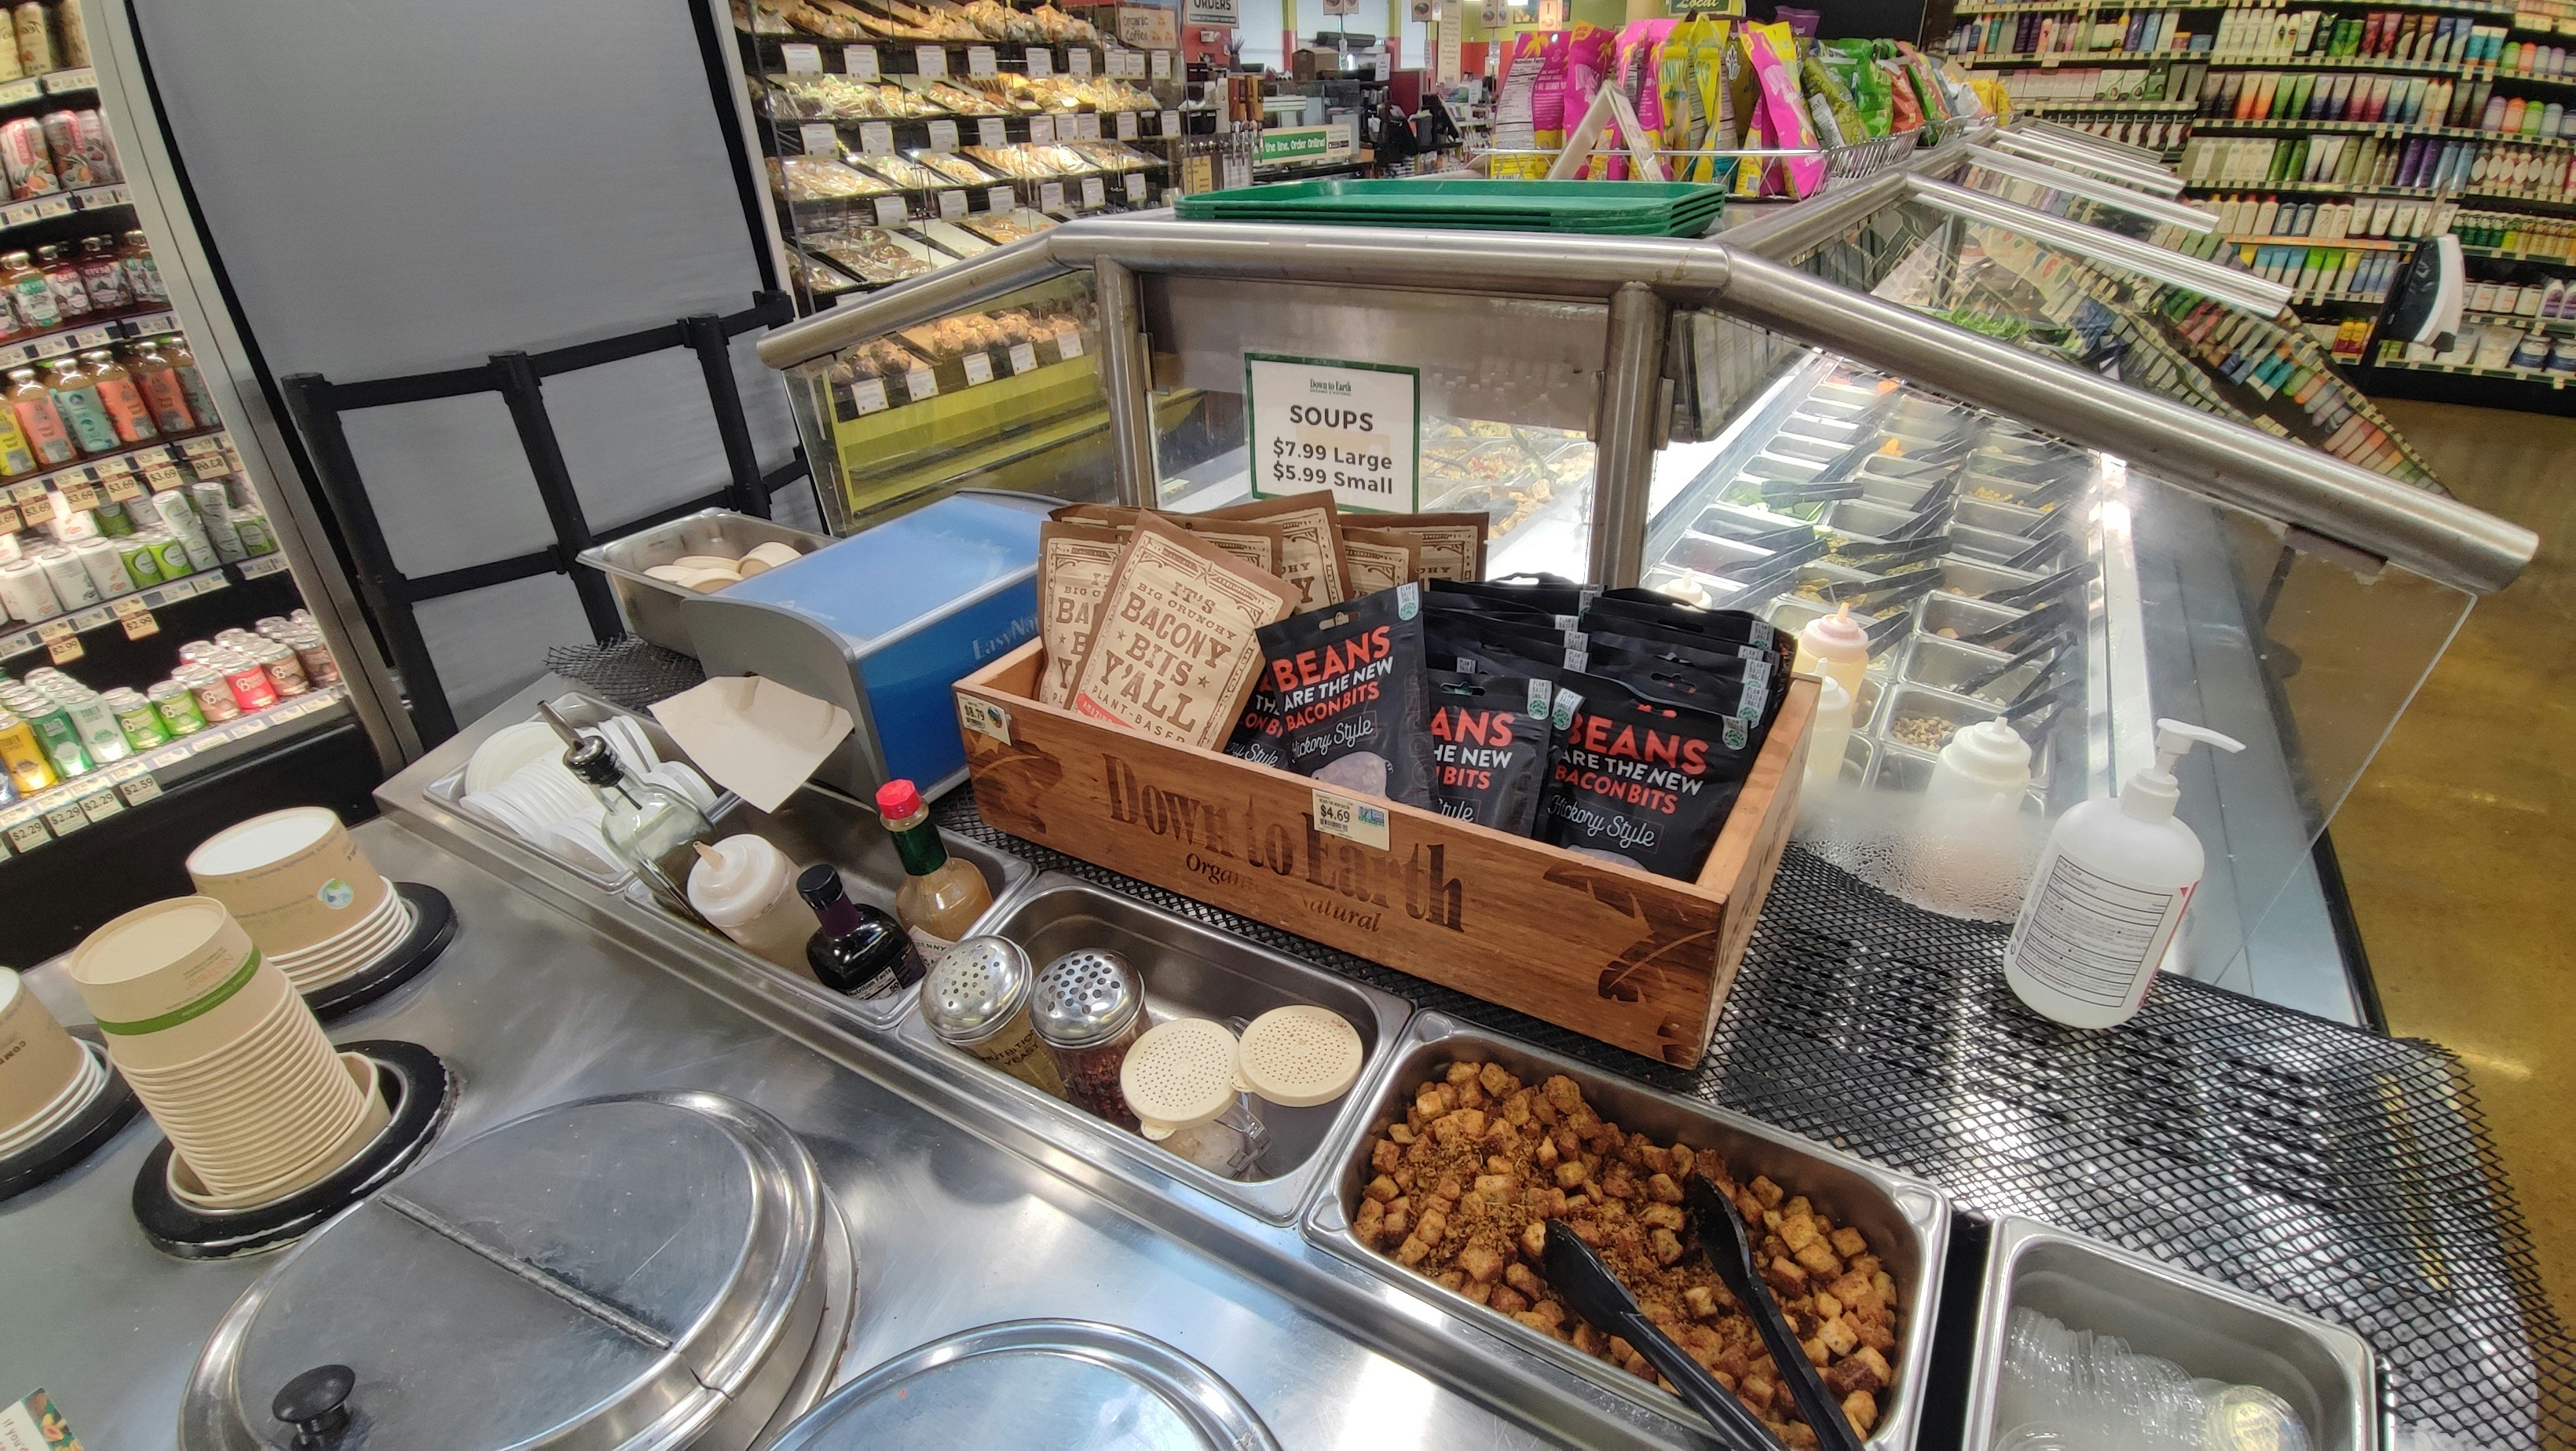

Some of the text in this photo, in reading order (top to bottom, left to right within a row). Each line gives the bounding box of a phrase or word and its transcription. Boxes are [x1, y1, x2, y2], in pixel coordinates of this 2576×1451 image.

[1123, 16, 1150, 30] Organic
[1125, 30, 1148, 42] Coffee
[1265, 142, 1276, 152] the
[1290, 139, 1307, 150] Order
[1310, 378, 1327, 389] Down
[1335, 381, 1352, 392] Earth
[1290, 404, 1374, 432] SOUPS
[1273, 437, 1392, 471] $7.99 Large
[108, 479, 134, 494] $3.69
[149, 469, 177, 483] $3.69
[1273, 460, 1392, 494] $5.99 Small
[68, 490, 93, 505] $3.69
[24, 502, 51, 517] $3.69
[1065, 586, 1087, 596] BIG
[1171, 581, 1216, 614] IT'S
[1137, 582, 1237, 641] BIG CRUNCHY
[126, 616, 152, 631] $2.99
[1121, 591, 1232, 669] BACONY
[52, 641, 78, 656] $2.99
[1272, 625, 1392, 693] BEANS
[1125, 632, 1193, 687] BITS
[1100, 649, 1196, 733] Y'ALL
[1284, 656, 1394, 712] ARE THE NEW
[964, 704, 985, 721] $8.79
[1257, 694, 1281, 716] TH
[1335, 715, 1374, 747] Style
[1431, 706, 1516, 747] ANS
[1569, 711, 1710, 775] BEANS
[1434, 744, 1513, 769] HE NEW
[1562, 750, 1705, 797] ARE THE NEW
[124, 777, 155, 796] $2.59
[83, 792, 115, 812] $2.29
[50, 806, 80, 825] $2.29
[1320, 803, 1350, 823] $4.69
[1547, 794, 1656, 849] Hickory Style
[13, 822, 42, 841] $2.29
[1101, 752, 1465, 934] Down to Earth
[876, 969, 891, 981] Facts
[889, 981, 900, 993] 50
[1004, 1043, 1039, 1066] YEAST
